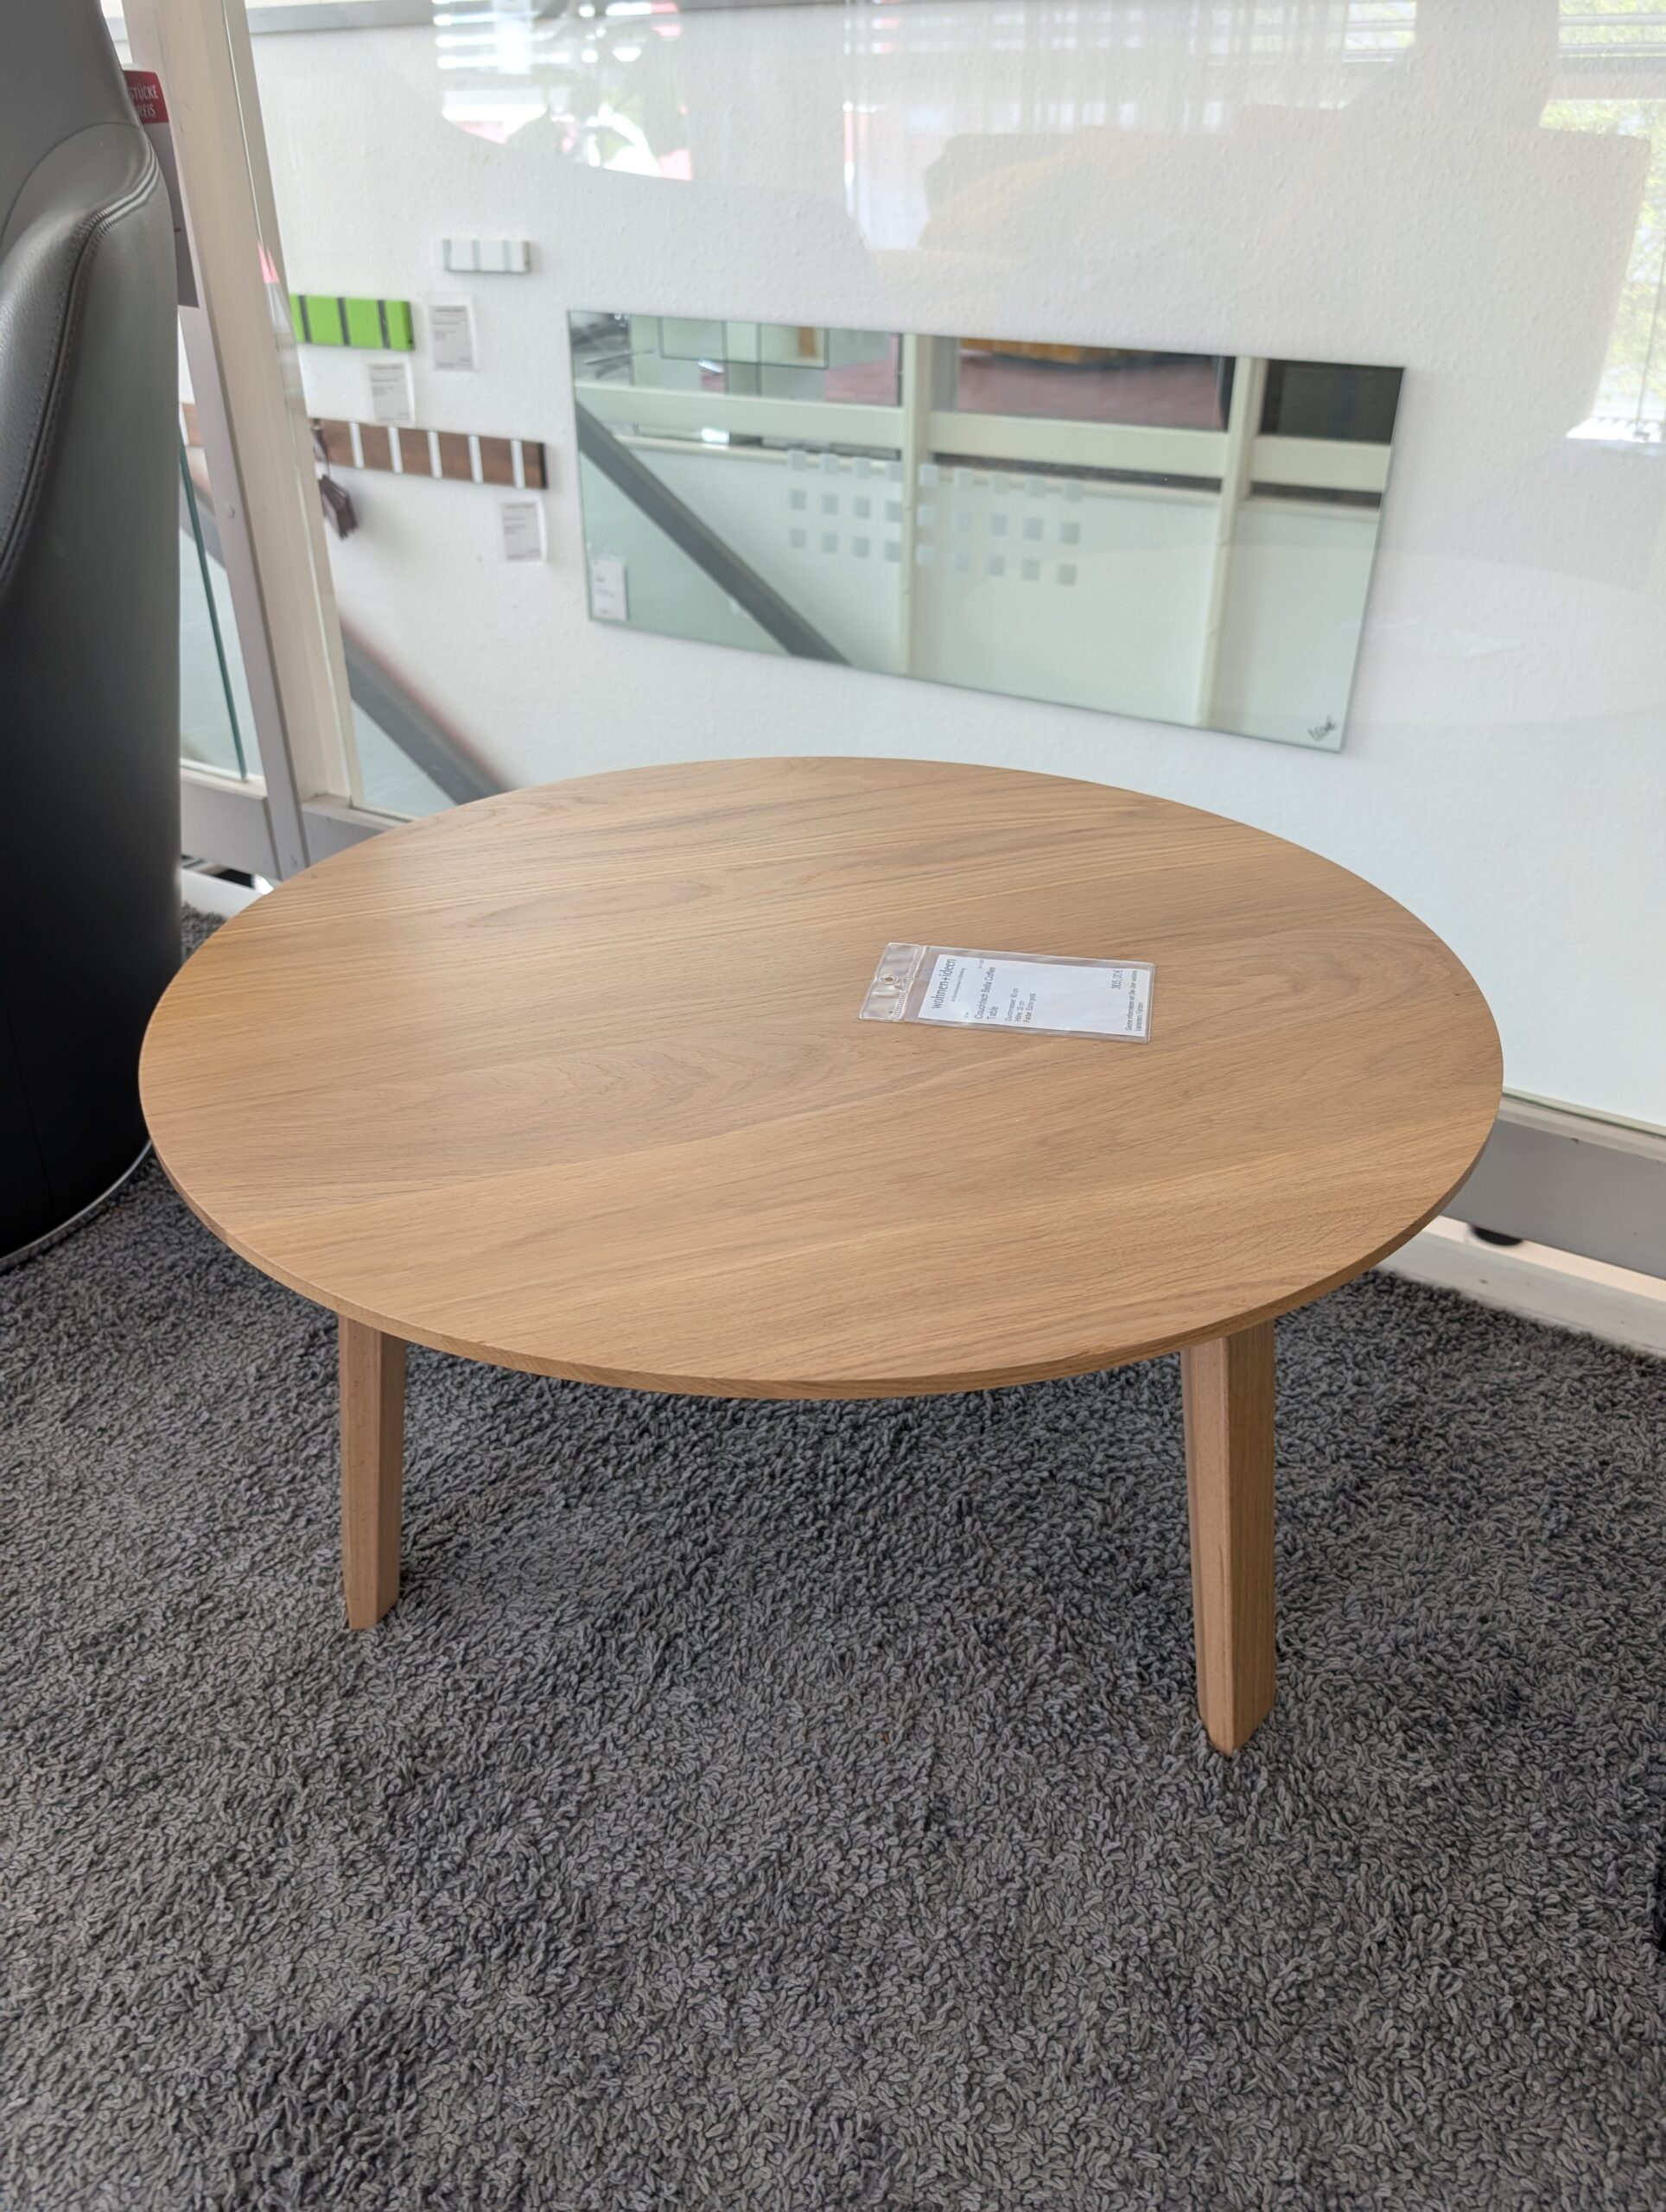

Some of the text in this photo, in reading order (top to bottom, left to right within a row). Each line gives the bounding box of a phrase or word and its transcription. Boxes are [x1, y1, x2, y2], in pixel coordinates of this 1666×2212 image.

[137, 104, 156, 118] REIS
[931, 959, 957, 1008] wohnen+ideen
[975, 967, 995, 1019] Couchtisch Bella Coffee
[987, 1007, 998, 1020] Table
